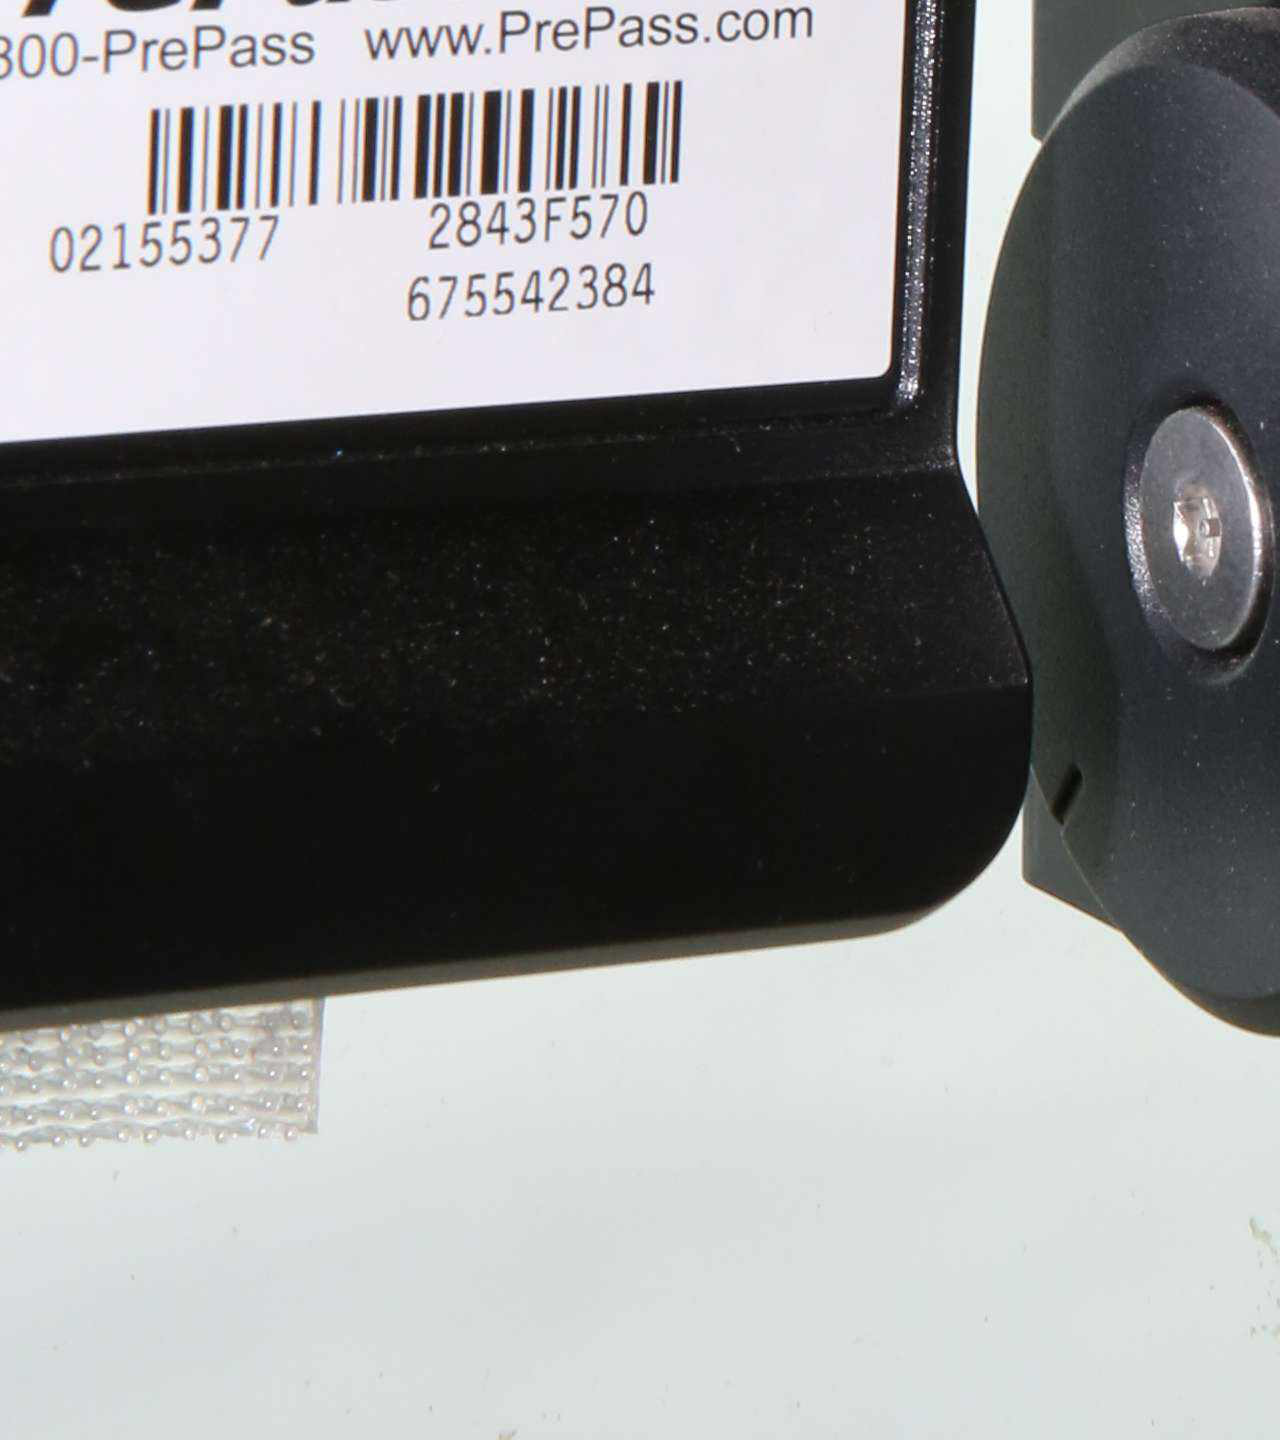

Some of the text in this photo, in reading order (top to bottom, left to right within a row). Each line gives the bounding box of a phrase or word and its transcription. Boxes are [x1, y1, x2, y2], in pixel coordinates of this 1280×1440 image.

[364, 1, 814, 61] www.PrePass.com
[51, 215, 279, 273] 02155377
[429, 192, 648, 250] 2843F570
[408, 262, 655, 321] 675542384
